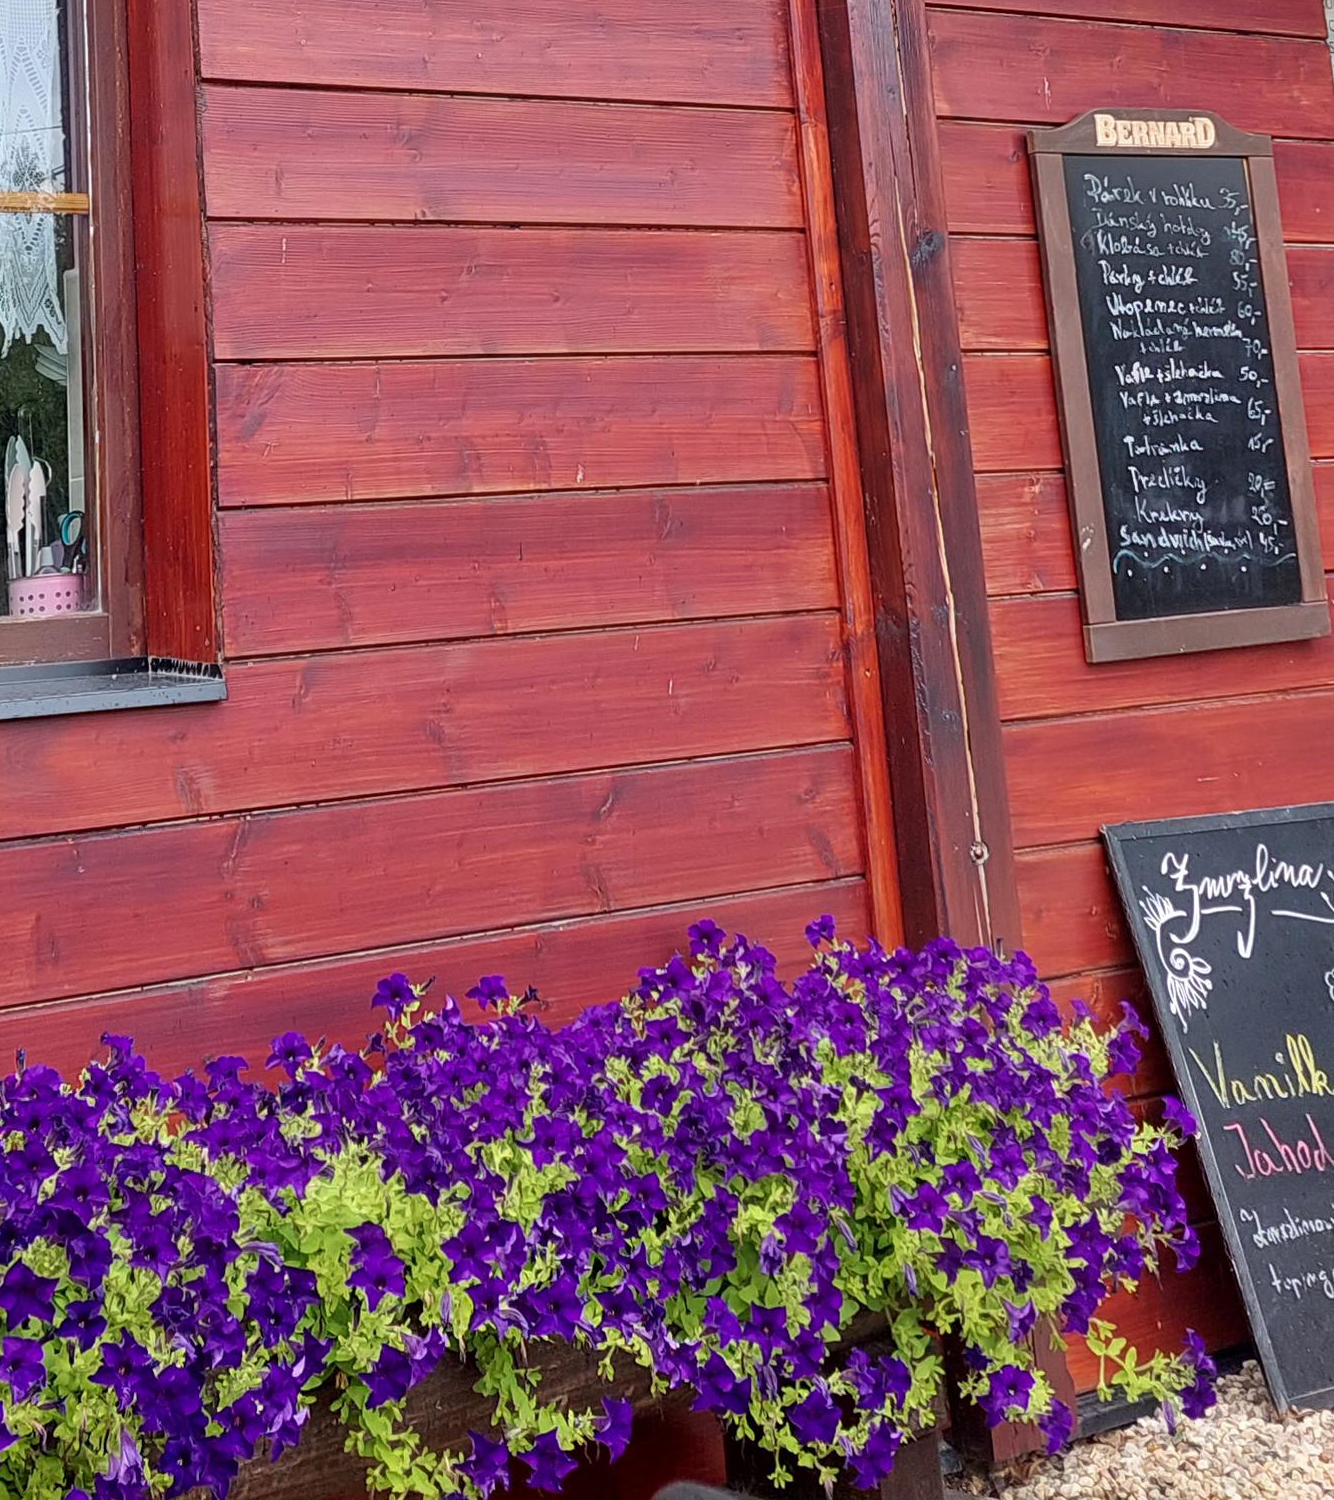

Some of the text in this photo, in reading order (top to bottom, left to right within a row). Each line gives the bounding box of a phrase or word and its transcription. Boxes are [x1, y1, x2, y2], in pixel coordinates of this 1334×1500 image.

[1094, 114, 1216, 148] BERNARD
[1083, 173, 1144, 204] Párek
[1149, 190, 1157, 204] v
[1239, 366, 1269, 388] 50,-
[1161, 843, 1323, 959] Zmrzlina
